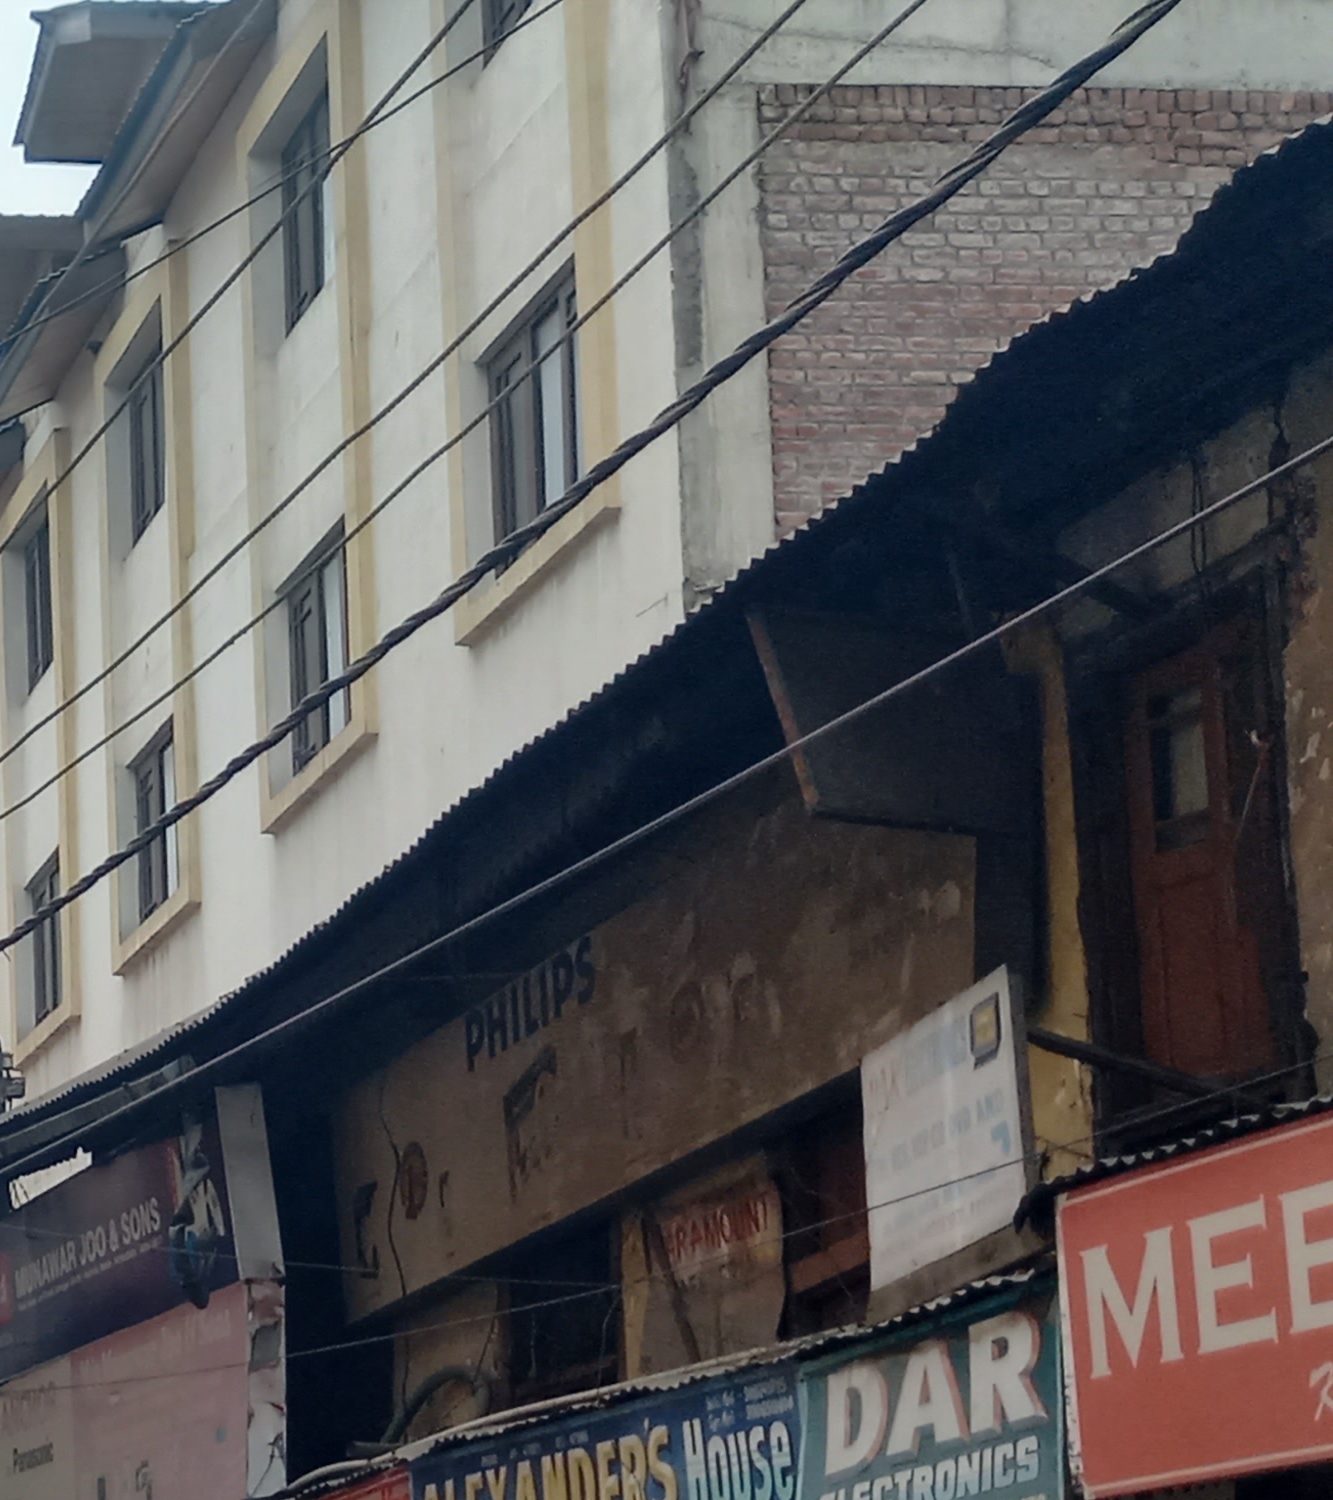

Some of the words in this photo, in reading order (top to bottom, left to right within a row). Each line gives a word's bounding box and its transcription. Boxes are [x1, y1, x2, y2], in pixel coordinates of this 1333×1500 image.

[464, 935, 596, 1073] PHILIPS
[14, 1236, 77, 1300] MUNAWAR
[79, 1225, 107, 1265] JOO
[108, 1218, 120, 1253] &
[122, 1196, 162, 1246] SONS
[823, 1310, 1050, 1479] DAR
